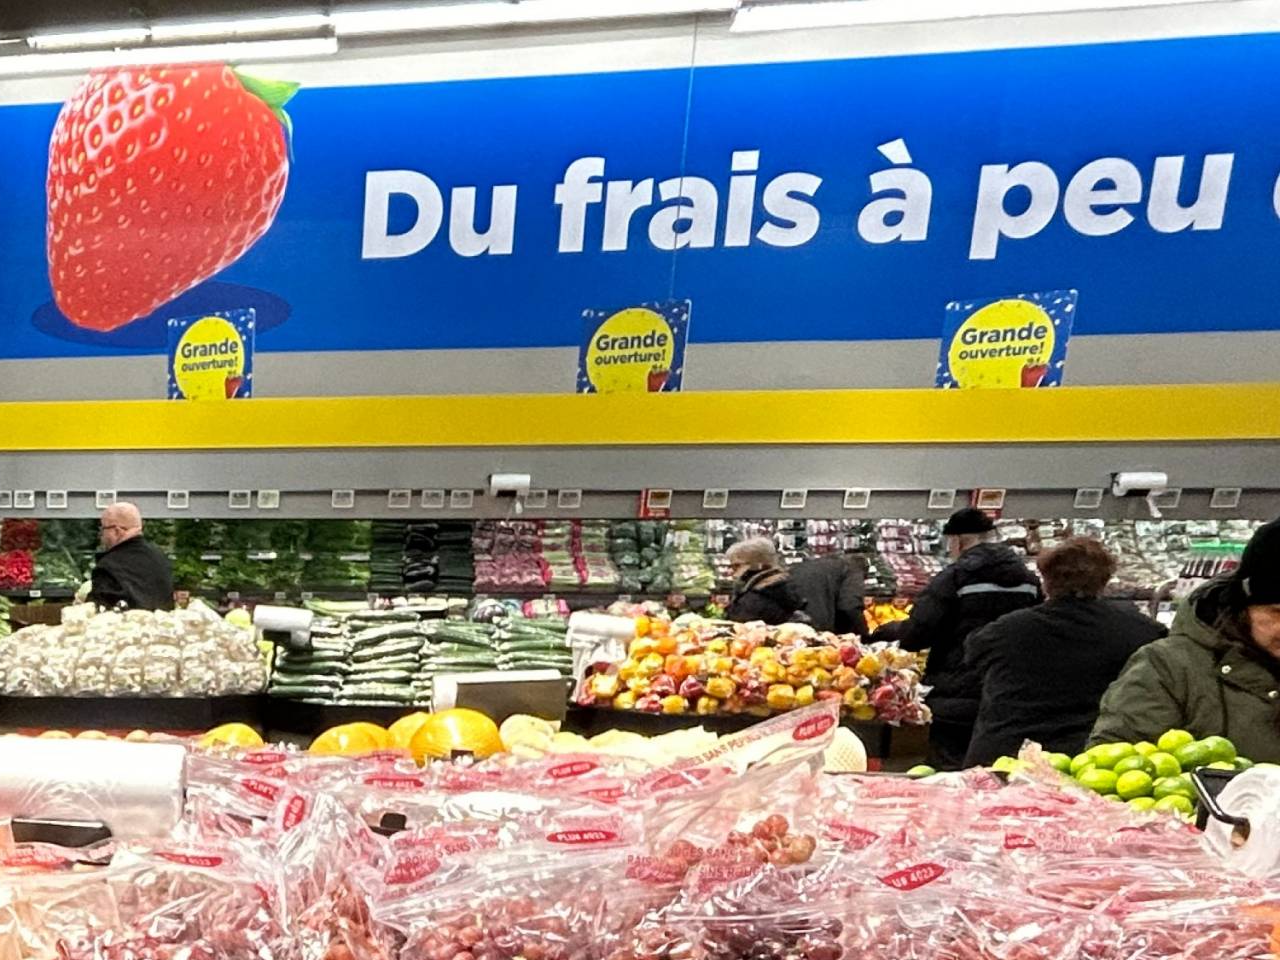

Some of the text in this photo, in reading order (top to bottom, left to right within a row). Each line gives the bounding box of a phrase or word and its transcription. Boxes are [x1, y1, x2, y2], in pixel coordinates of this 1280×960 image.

[361, 169, 516, 260] Du
[554, 149, 822, 254] frais
[857, 137, 932, 244] à
[969, 152, 1235, 261] peu
[595, 330, 668, 351] Grande
[961, 321, 1048, 345] Grande
[181, 338, 238, 358] Grande
[594, 349, 666, 366] ouverture!
[958, 342, 1045, 360] ouverture!
[181, 356, 238, 372] ouverture!
